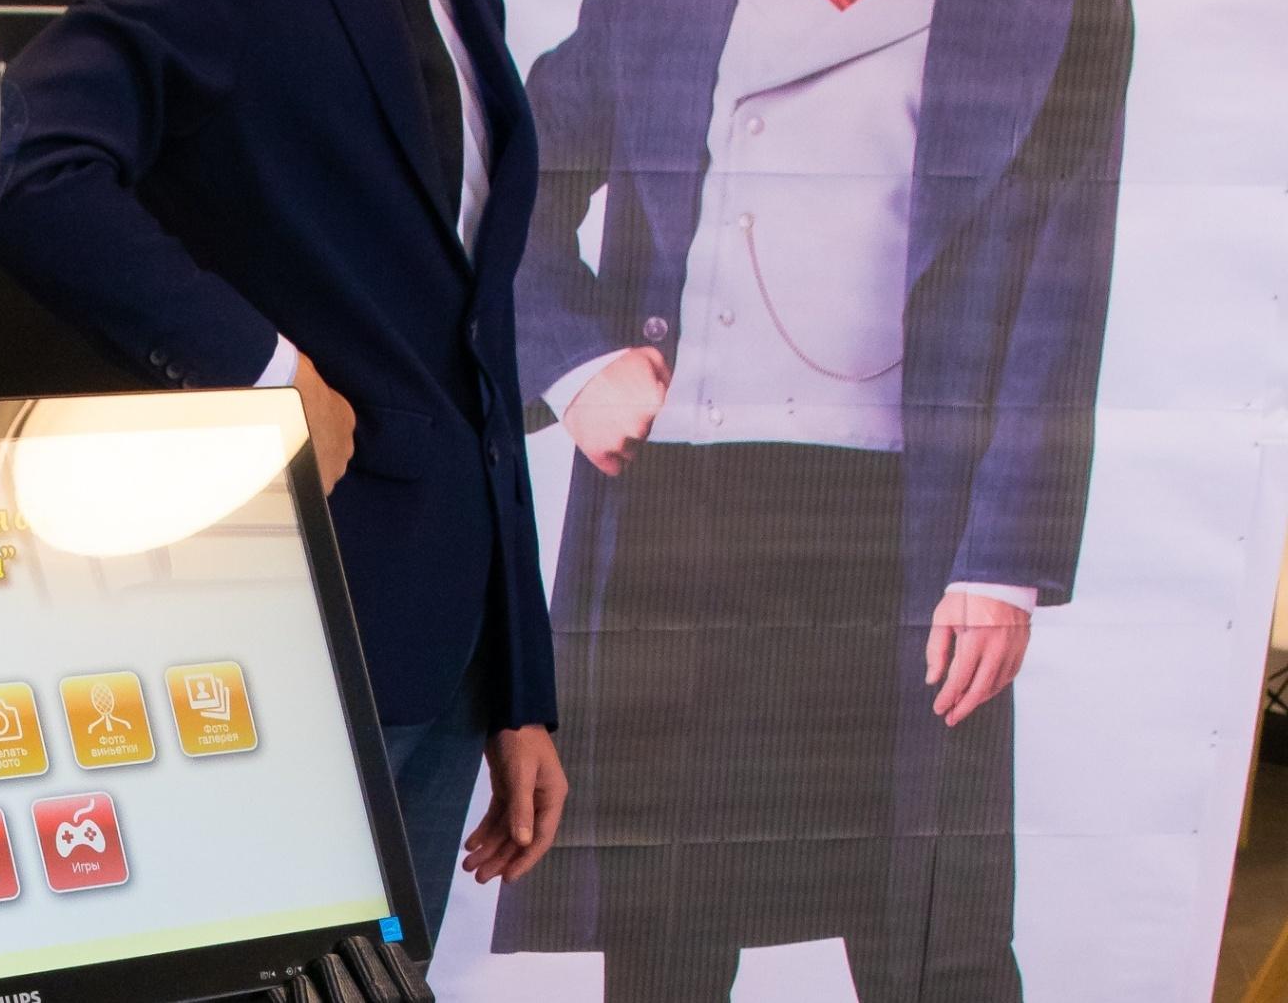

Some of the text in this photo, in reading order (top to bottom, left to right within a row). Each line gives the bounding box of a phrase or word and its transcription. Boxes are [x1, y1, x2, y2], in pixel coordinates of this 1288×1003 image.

[203, 723, 229, 734] Фото
[99, 734, 126, 745] Фото
[71, 861, 101, 875] Игры
